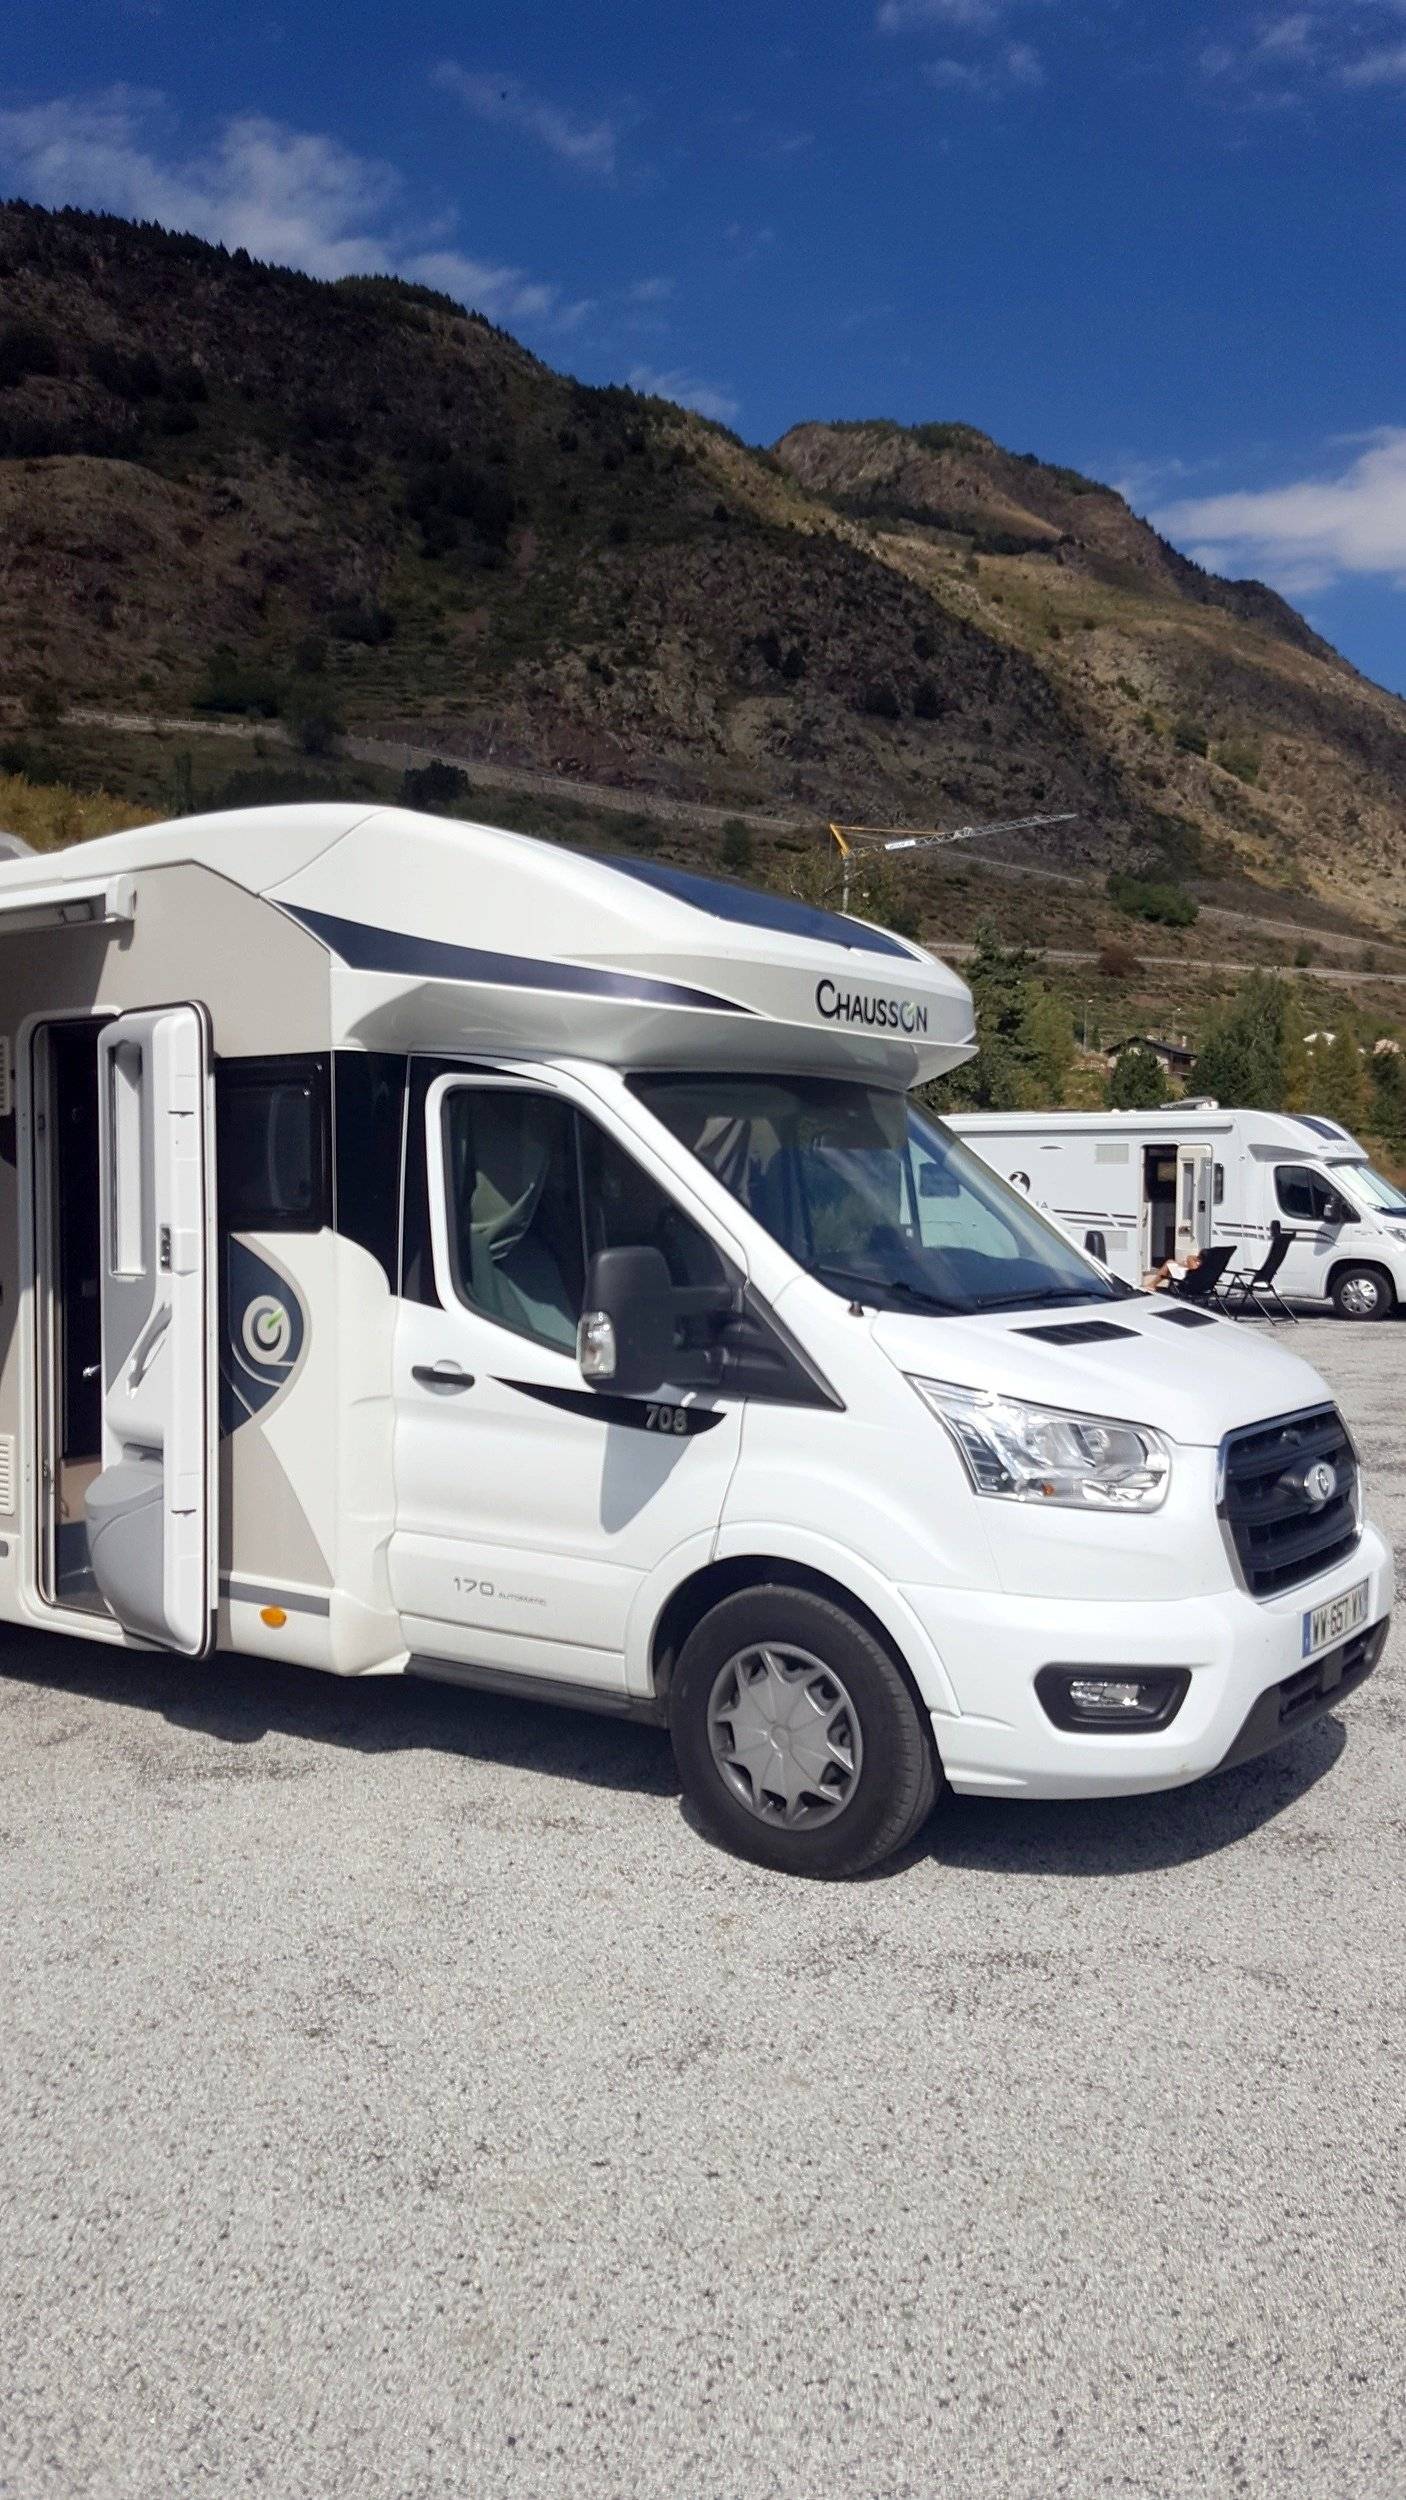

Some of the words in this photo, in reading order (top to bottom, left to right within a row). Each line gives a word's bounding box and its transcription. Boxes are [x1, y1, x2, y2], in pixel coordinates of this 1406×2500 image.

[815, 979, 928, 1033] CHAUSSON
[645, 1402, 688, 1434] 708
[453, 1577, 495, 1596] 170
